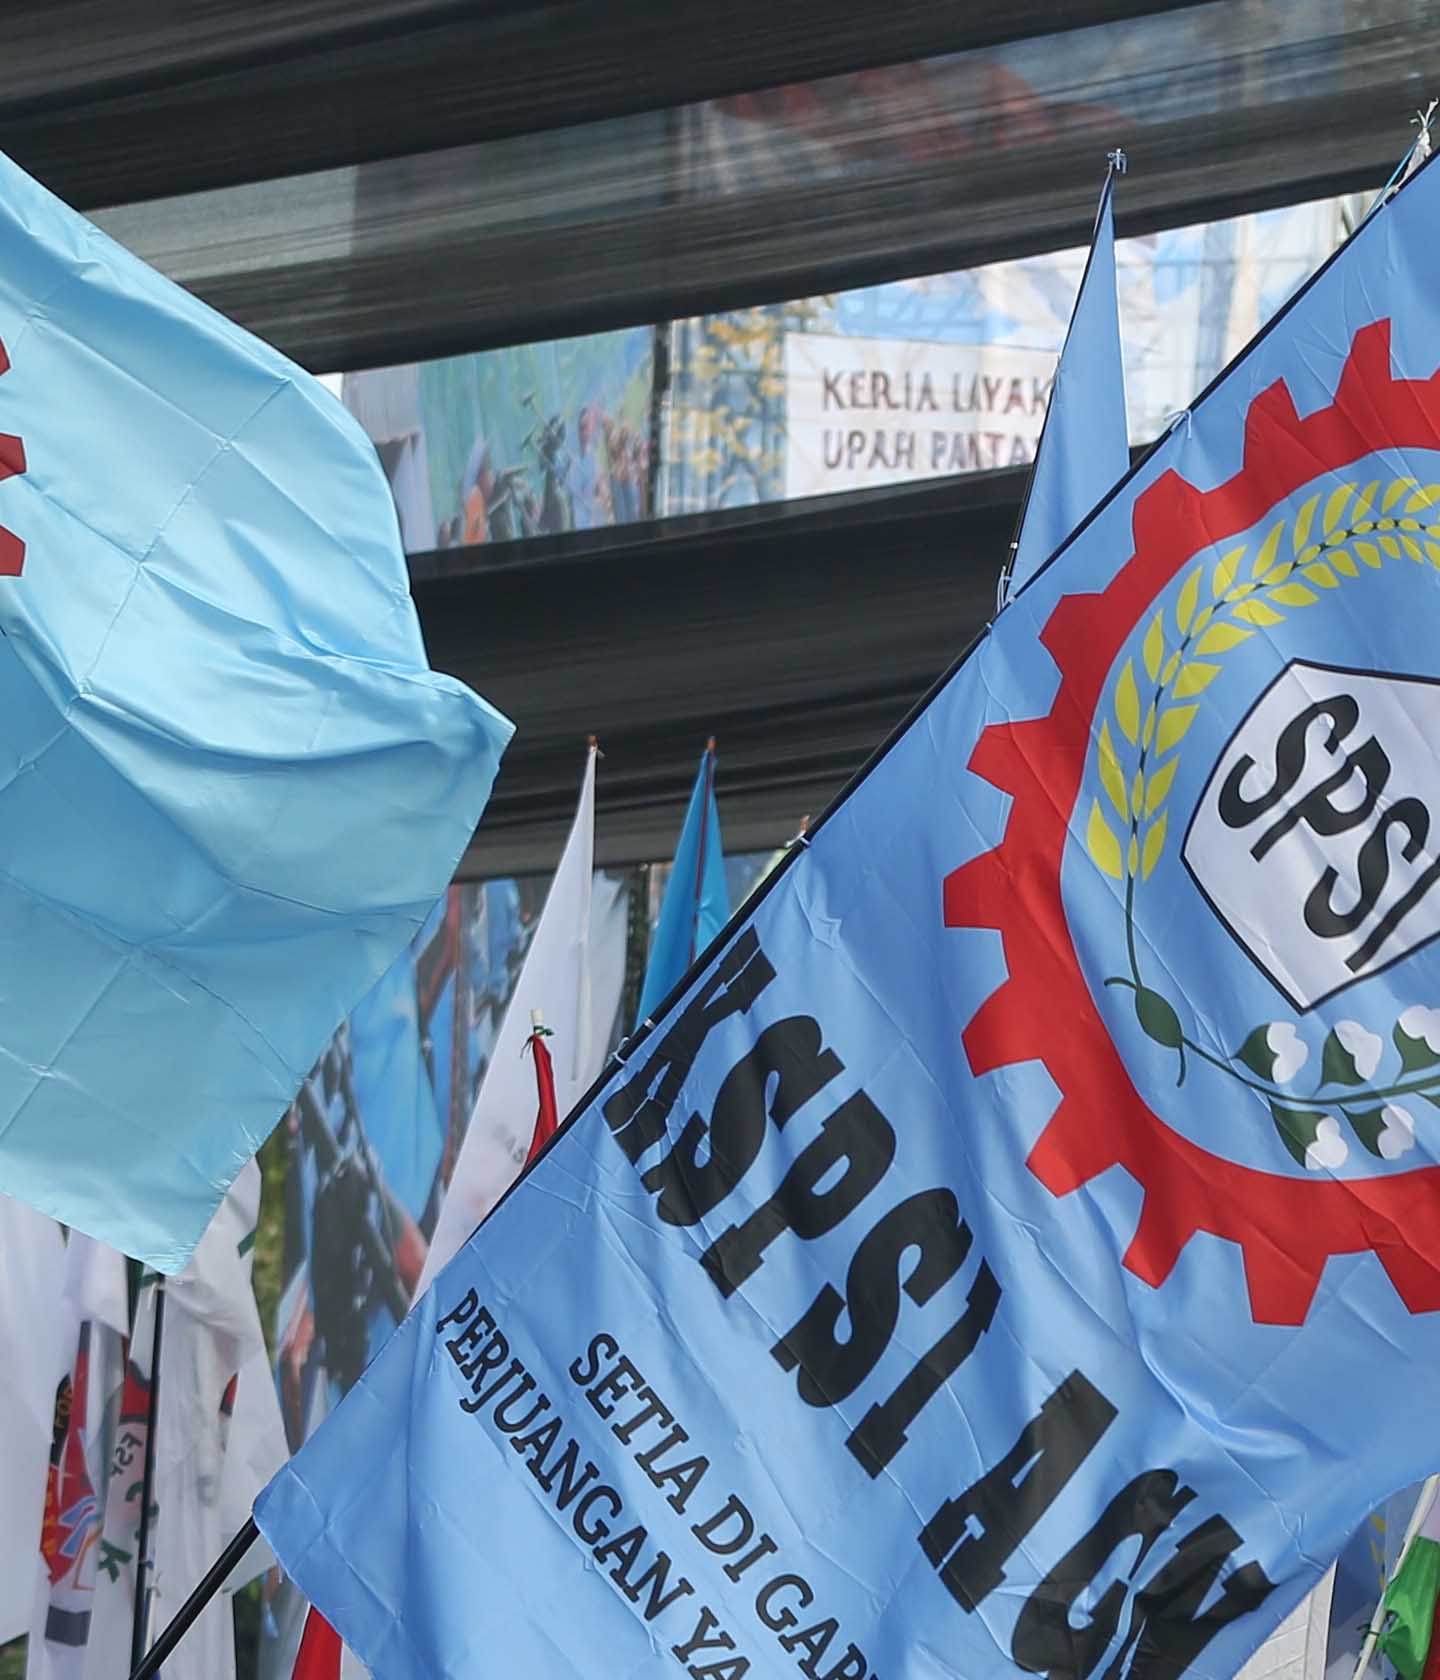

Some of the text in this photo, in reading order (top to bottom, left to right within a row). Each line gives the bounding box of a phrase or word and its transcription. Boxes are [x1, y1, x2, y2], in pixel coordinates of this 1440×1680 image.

[823, 429, 1040, 470] UPAH PANTA
[601, 926, 1001, 1479] KSPSI
[435, 1288, 687, 1623] PERJUANGAN
[568, 1331, 711, 1517] SETIA
[693, 1492, 779, 1582] DI
